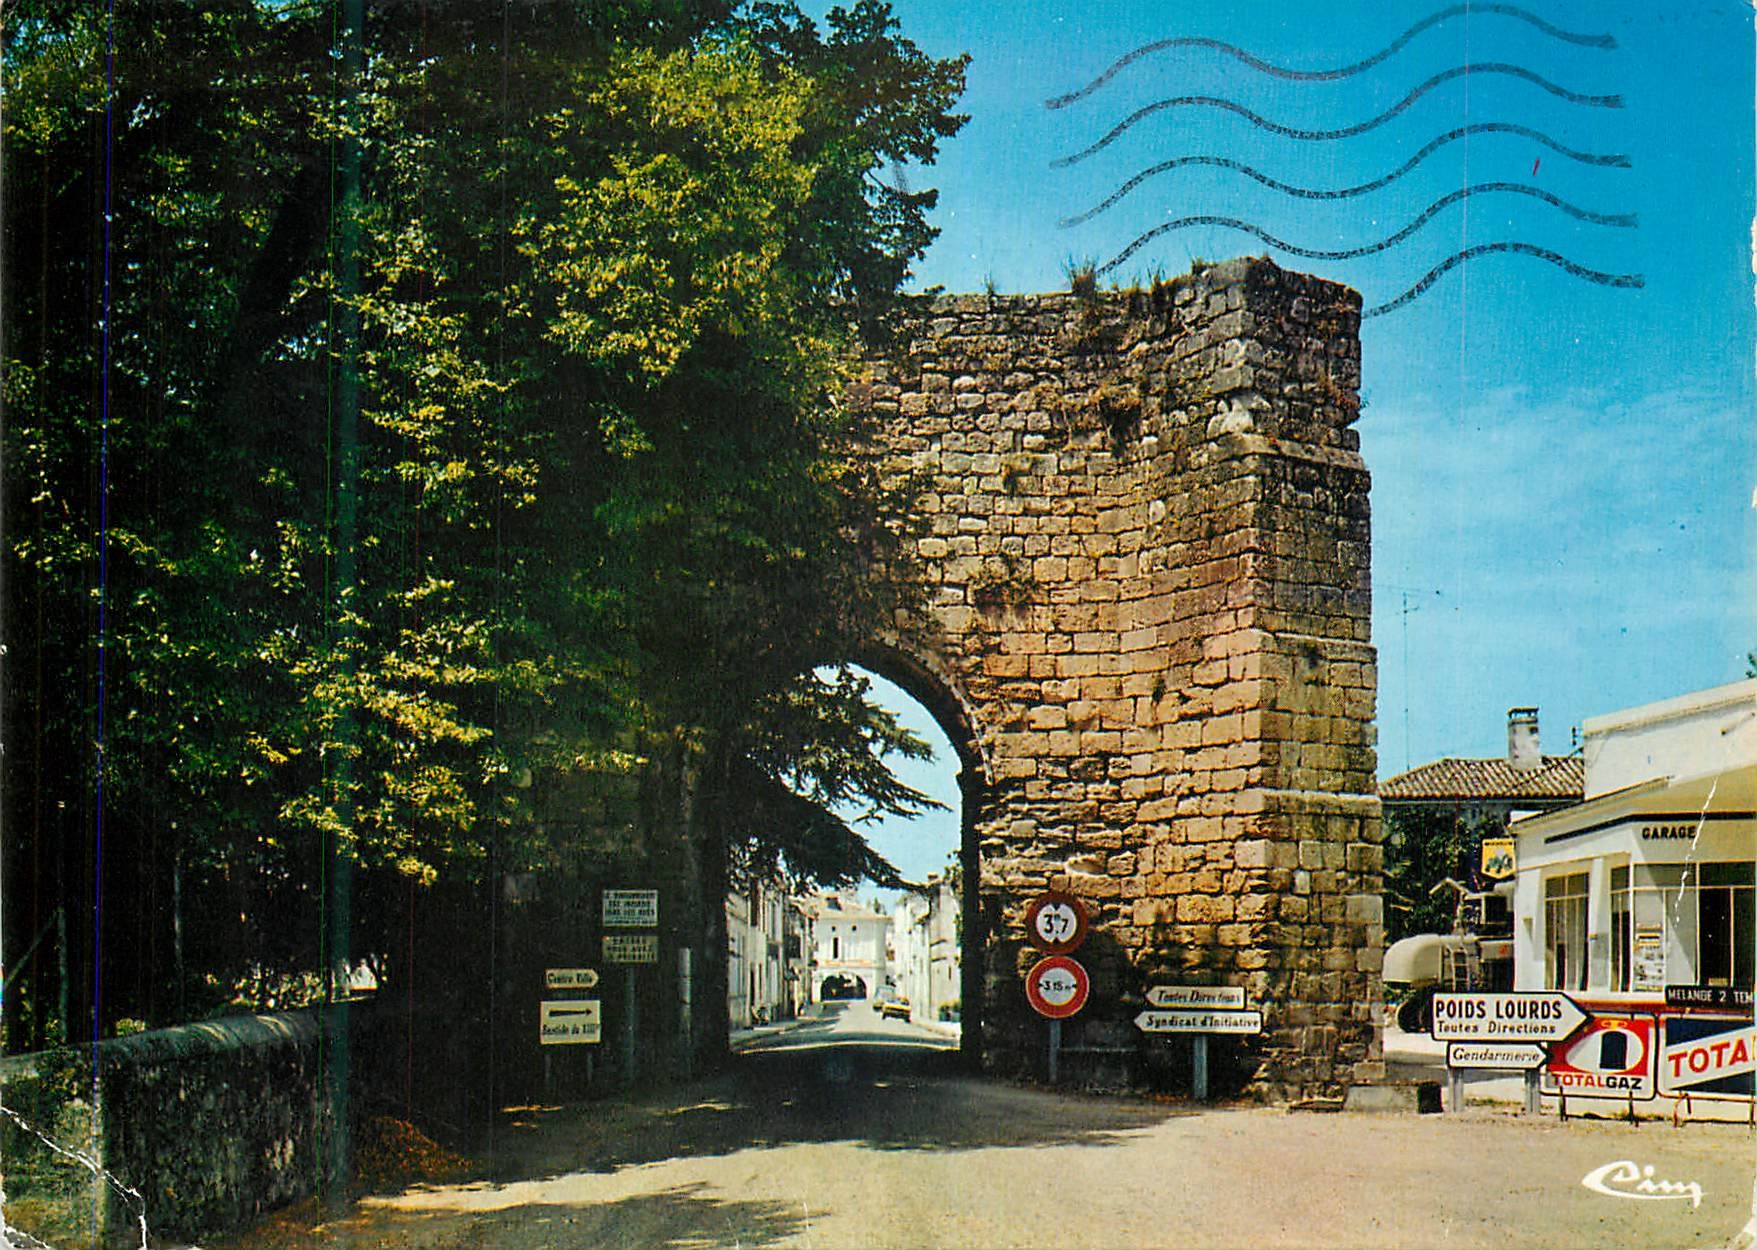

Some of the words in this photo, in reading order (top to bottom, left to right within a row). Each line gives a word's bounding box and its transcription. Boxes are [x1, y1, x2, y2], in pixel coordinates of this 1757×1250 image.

[1642, 825, 1697, 840] GARAGE
[1668, 988, 1712, 1002] MELANGE
[1720, 991, 1727, 1003] 2
[1435, 1000, 1486, 1019] POIDS
[1496, 1000, 1562, 1019] LOURDS
[1147, 1015, 1197, 1028] Syndicat
[1200, 1015, 1258, 1027] d'Initiative
[1437, 1020, 1479, 1033] Toutes
[1488, 1020, 1556, 1034] Directions
[1453, 1047, 1540, 1061] Gendarmerie
[1667, 1035, 1756, 1078] TOTA
[1553, 1074, 1642, 1090] TOTALGAZ
